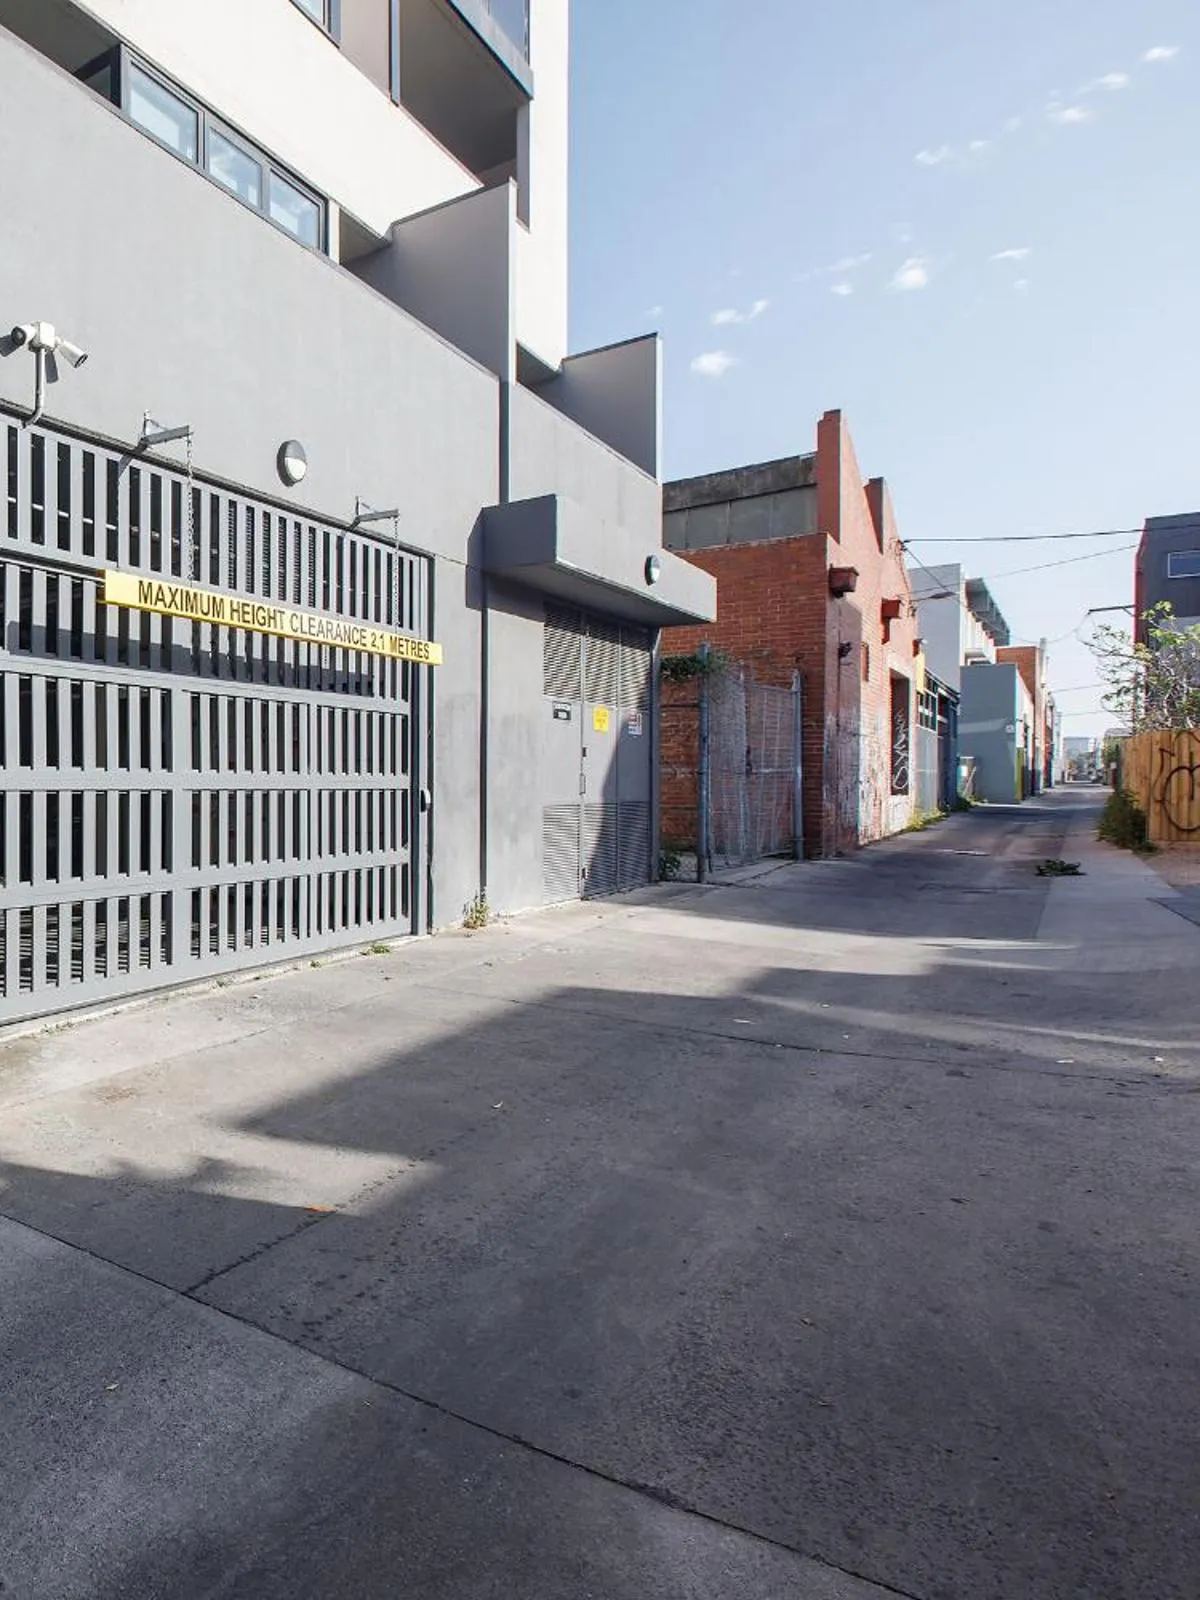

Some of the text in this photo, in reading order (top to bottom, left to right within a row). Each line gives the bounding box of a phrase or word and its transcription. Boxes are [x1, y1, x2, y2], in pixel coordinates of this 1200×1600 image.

[138, 580, 225, 619] MAXIMUM
[230, 600, 286, 629] HEIGHT
[289, 613, 368, 646] CLEARANCE
[389, 635, 430, 660] METRES
